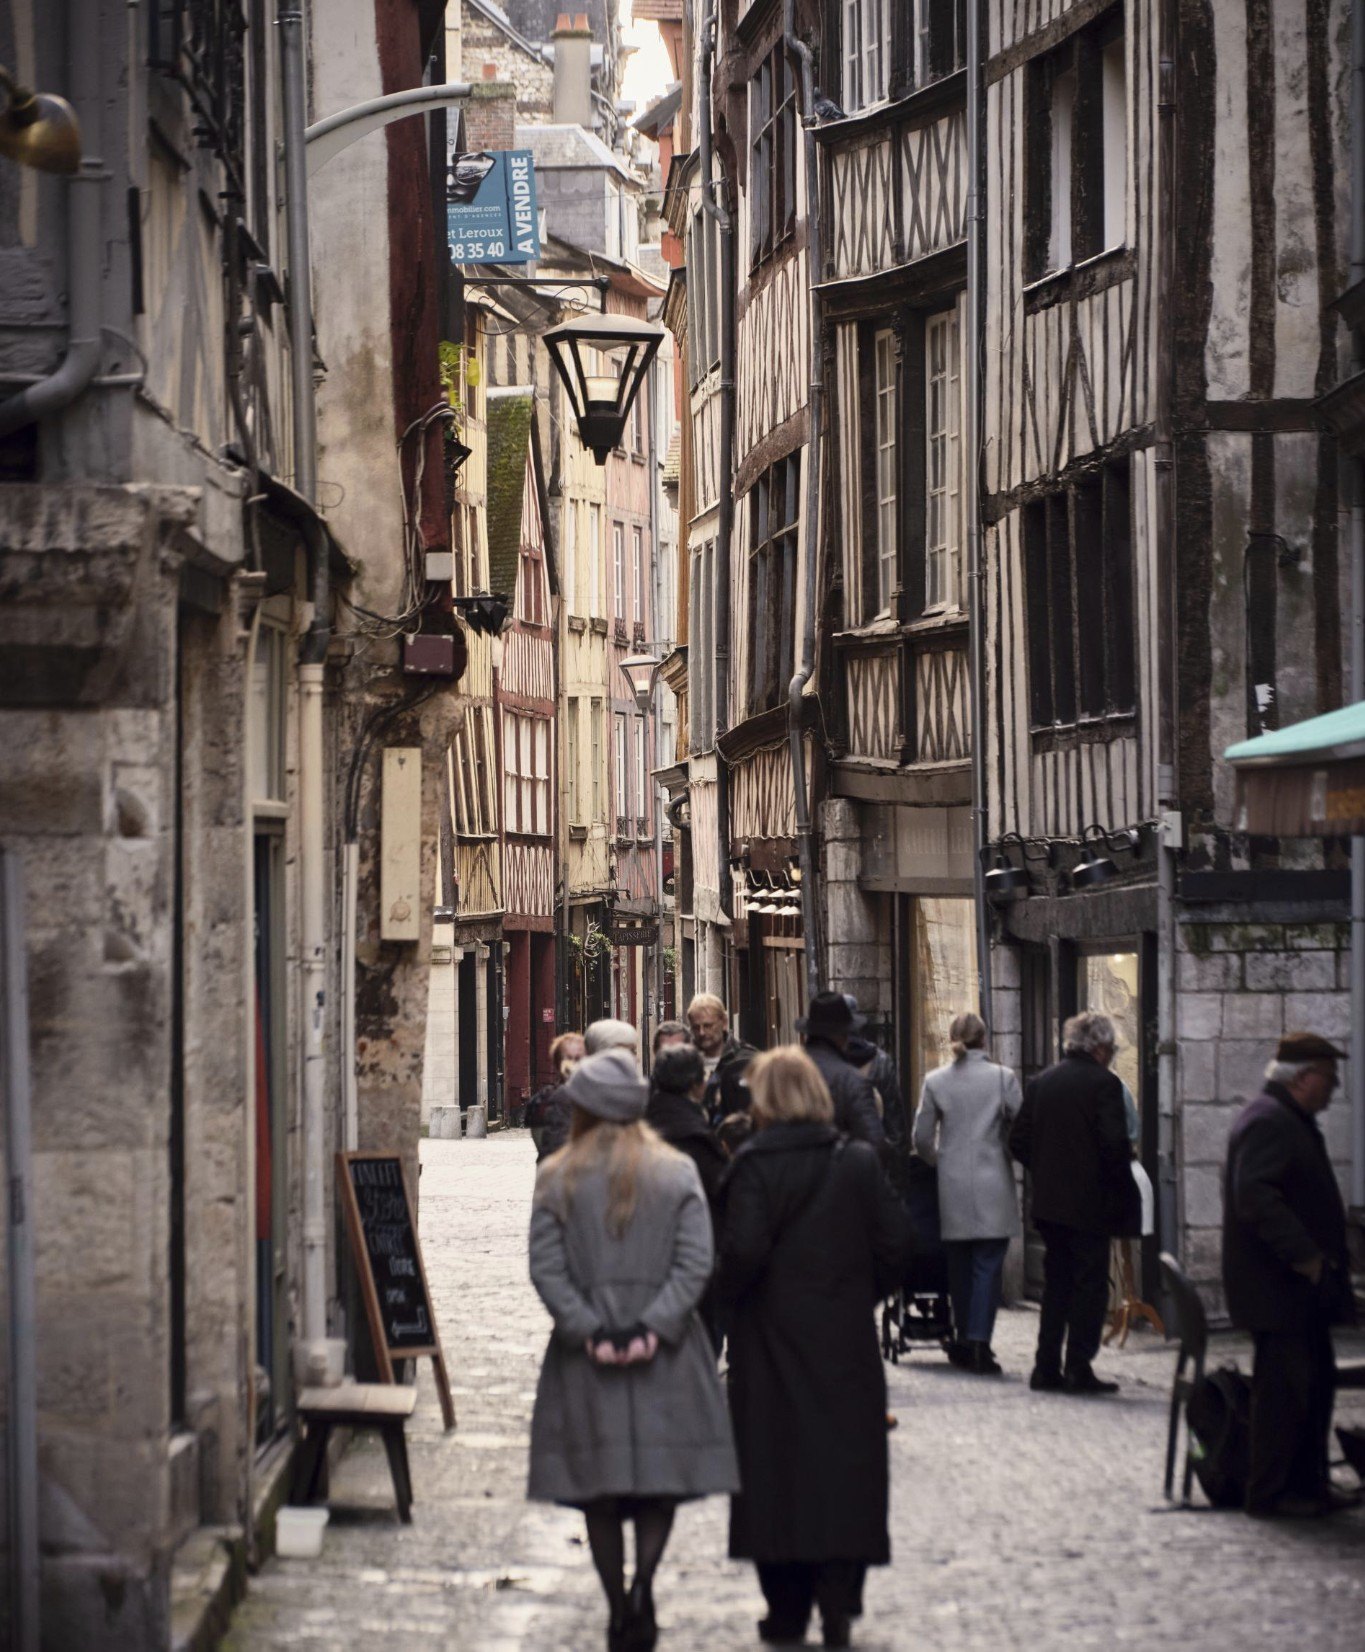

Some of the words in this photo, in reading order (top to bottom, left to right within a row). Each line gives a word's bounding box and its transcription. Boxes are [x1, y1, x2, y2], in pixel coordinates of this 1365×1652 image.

[511, 157, 533, 236] VENDRE
[458, 227, 503, 238] Leroux
[467, 242, 484, 258] 35
[487, 241, 504, 257] 40
[517, 238, 535, 255] A
